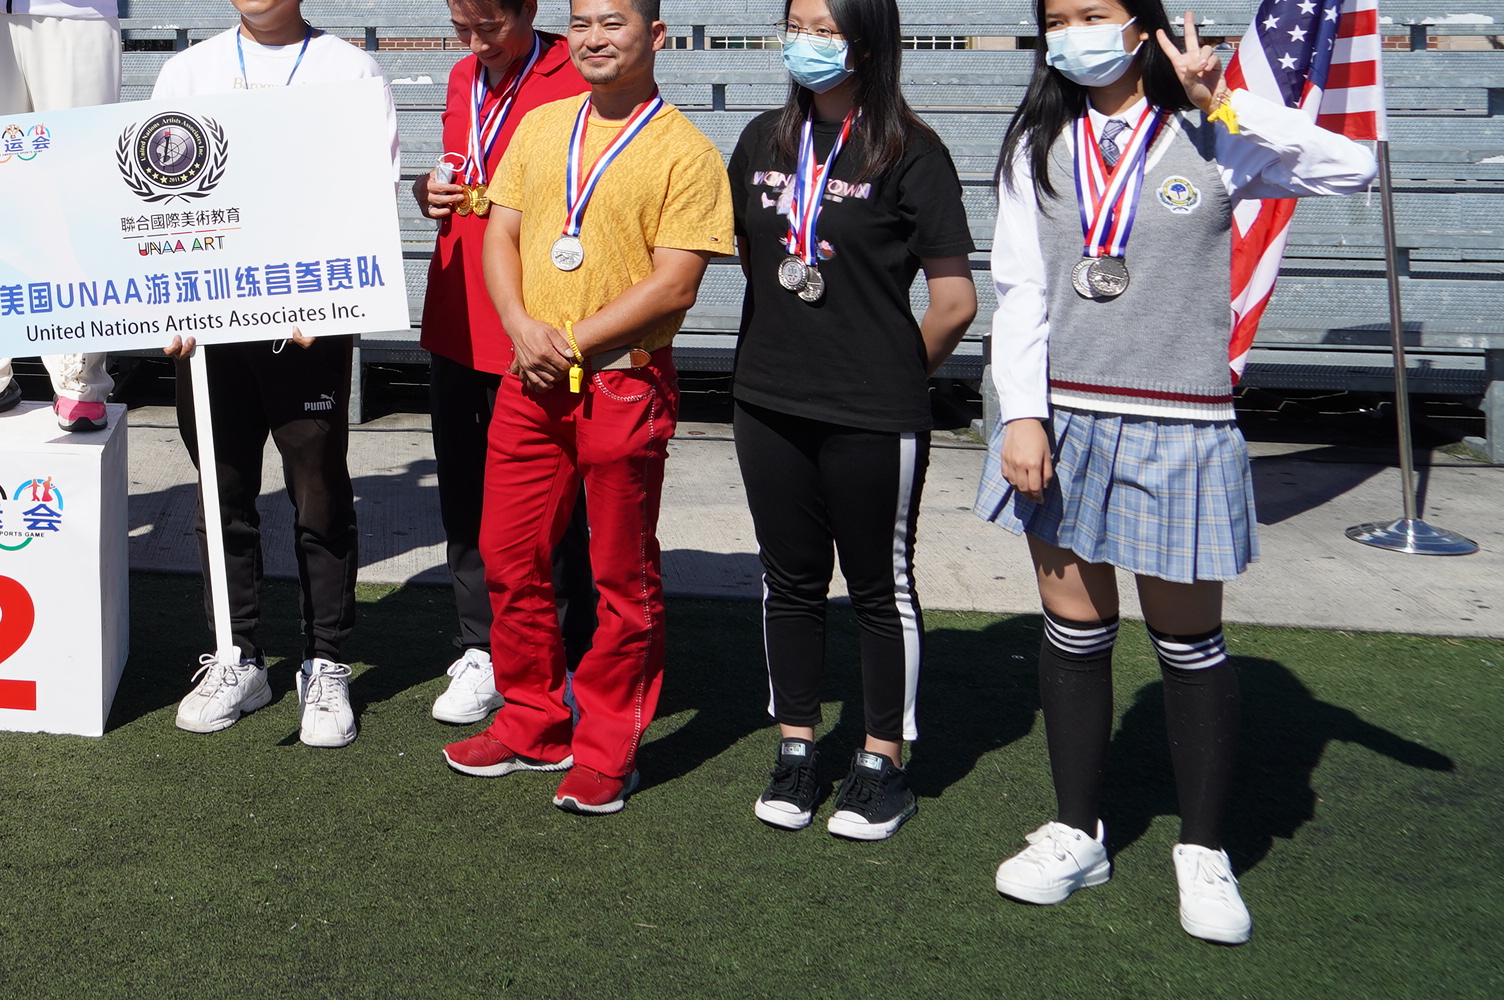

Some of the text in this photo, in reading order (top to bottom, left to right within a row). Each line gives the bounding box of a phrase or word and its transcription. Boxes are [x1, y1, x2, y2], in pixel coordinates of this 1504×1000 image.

[120, 206, 241, 233] 聯合國際美術教育
[137, 235, 226, 257] UNAA ART
[0, 254, 386, 317] 美国UNAA游泳训练营参赛队
[25, 301, 366, 343] United Nations Artists Associates Inc.
[303, 400, 333, 412] PUMA
[24, 531, 46, 539] GAME
